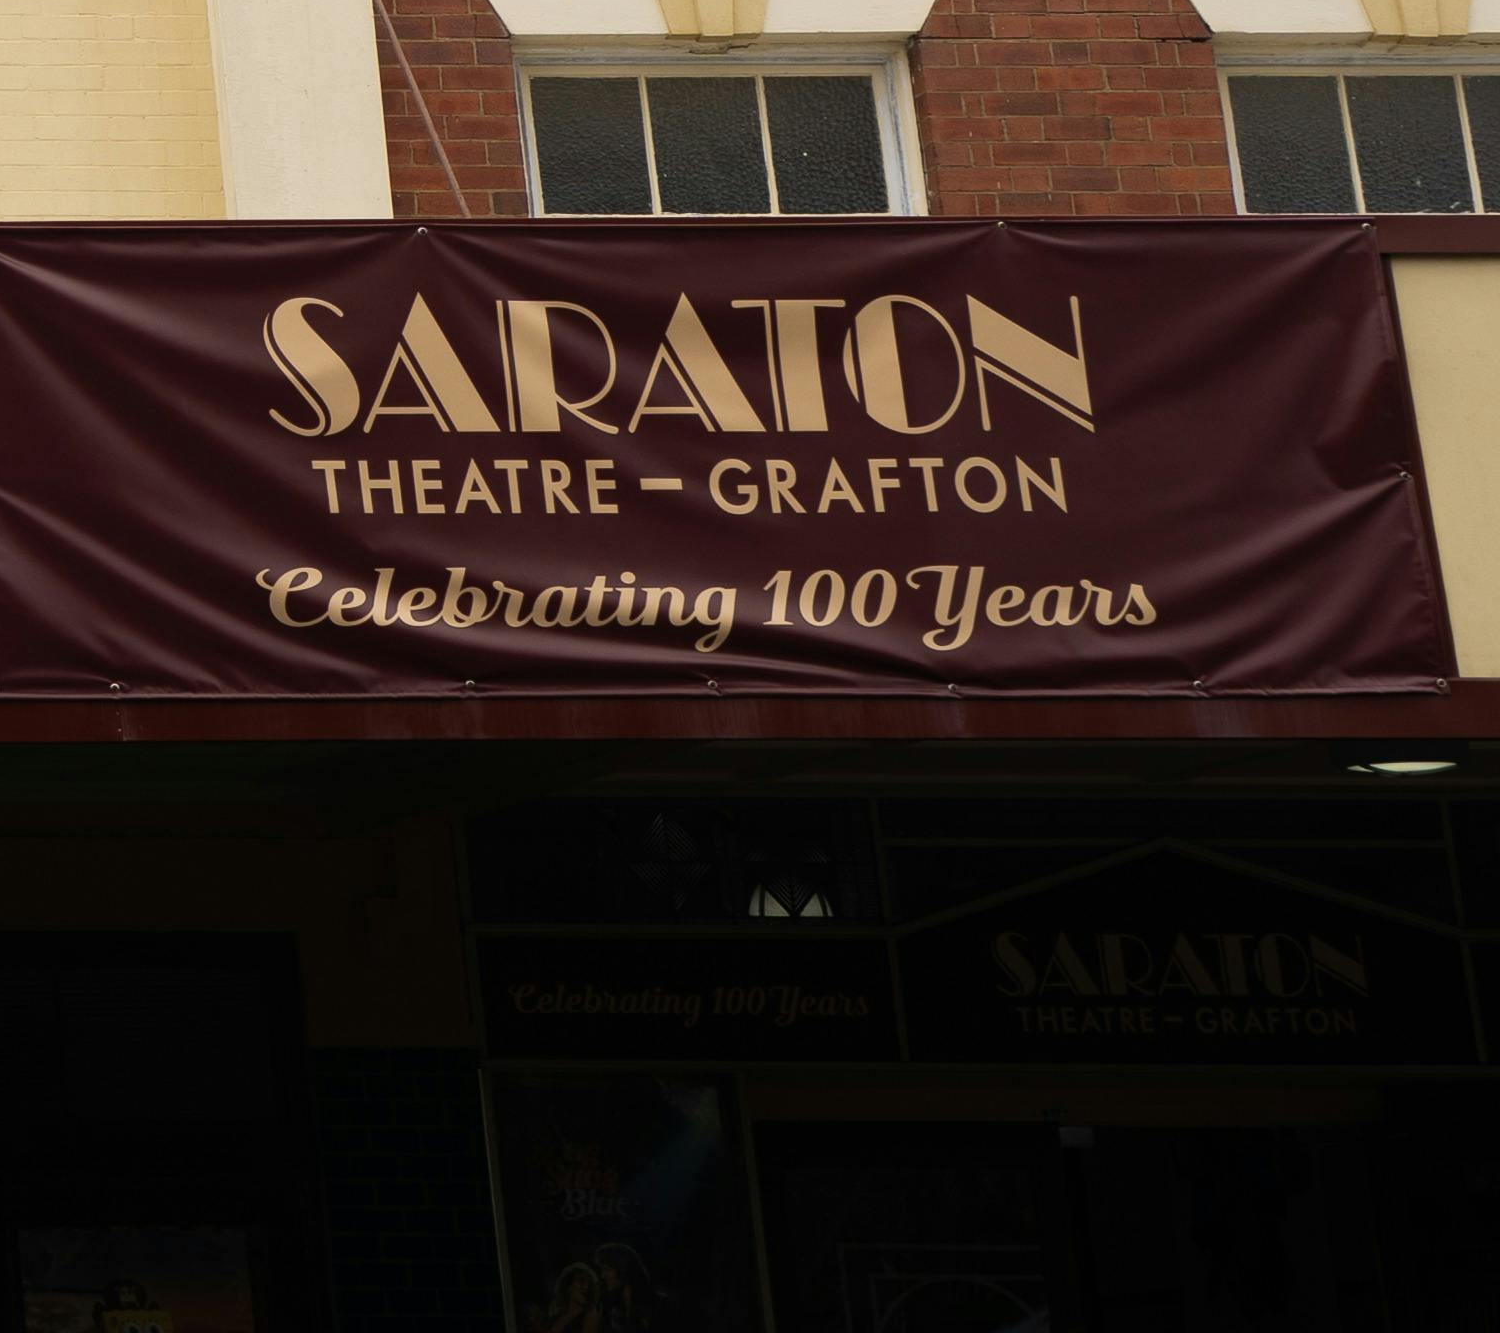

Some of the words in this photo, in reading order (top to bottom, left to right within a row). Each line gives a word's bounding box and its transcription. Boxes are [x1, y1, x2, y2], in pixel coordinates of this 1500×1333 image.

[263, 292, 1094, 437] SARATON
[311, 458, 619, 514] THEATRE
[709, 456, 1068, 515] GRAFTON
[255, 565, 738, 652] Celebrating
[762, 569, 897, 628] 100
[906, 565, 1157, 652] Years
[991, 930, 1373, 998] SARATON
[508, 982, 703, 1030] Celebrating
[711, 987, 766, 1015] 100
[768, 984, 872, 1029] Years
[1016, 1006, 1158, 1035] THEATRE
[1195, 1006, 1357, 1036] GRAFTON
